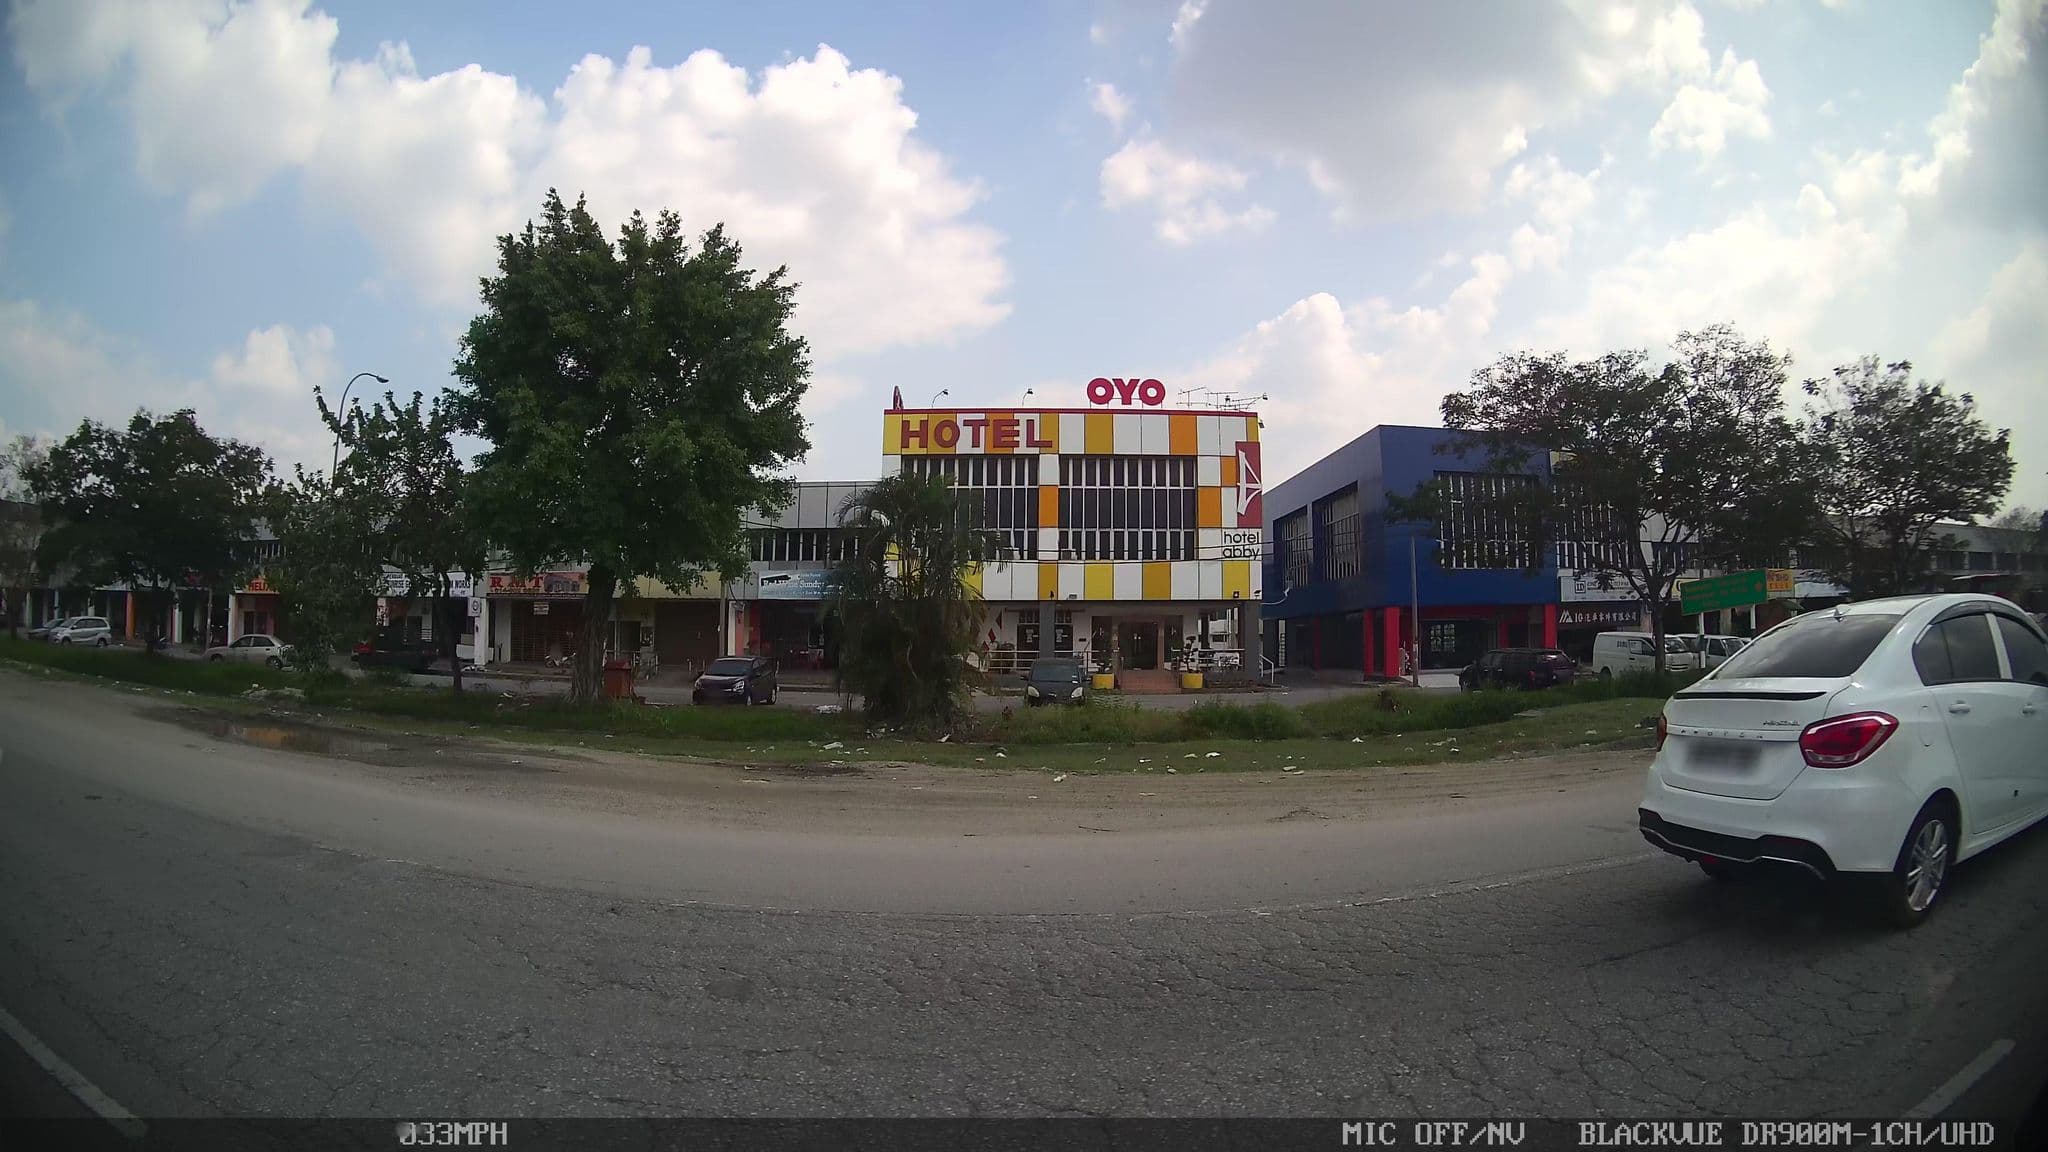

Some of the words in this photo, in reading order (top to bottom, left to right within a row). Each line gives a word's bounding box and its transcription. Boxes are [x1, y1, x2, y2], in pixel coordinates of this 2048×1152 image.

[1087, 377, 1166, 406] OYO
[901, 418, 1053, 449] HOTEL
[1223, 530, 1260, 545] hotel
[1222, 544, 1260, 561] abby
